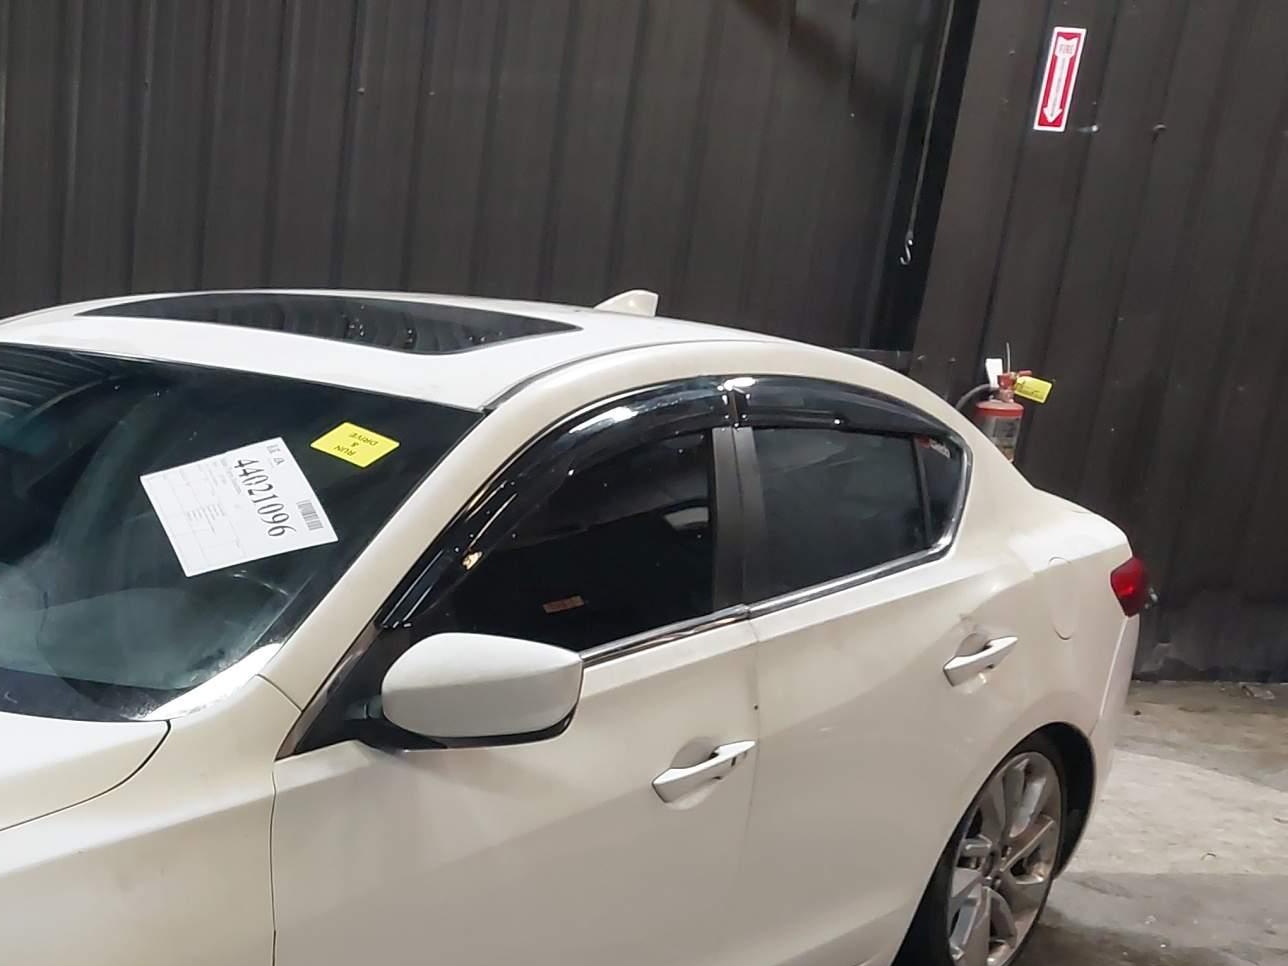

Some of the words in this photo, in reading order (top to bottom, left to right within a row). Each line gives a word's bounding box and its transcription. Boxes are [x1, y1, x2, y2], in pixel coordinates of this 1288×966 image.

[349, 433, 379, 446] DRIVE
[334, 445, 357, 457] RUN
[234, 459, 297, 537] 44021096
